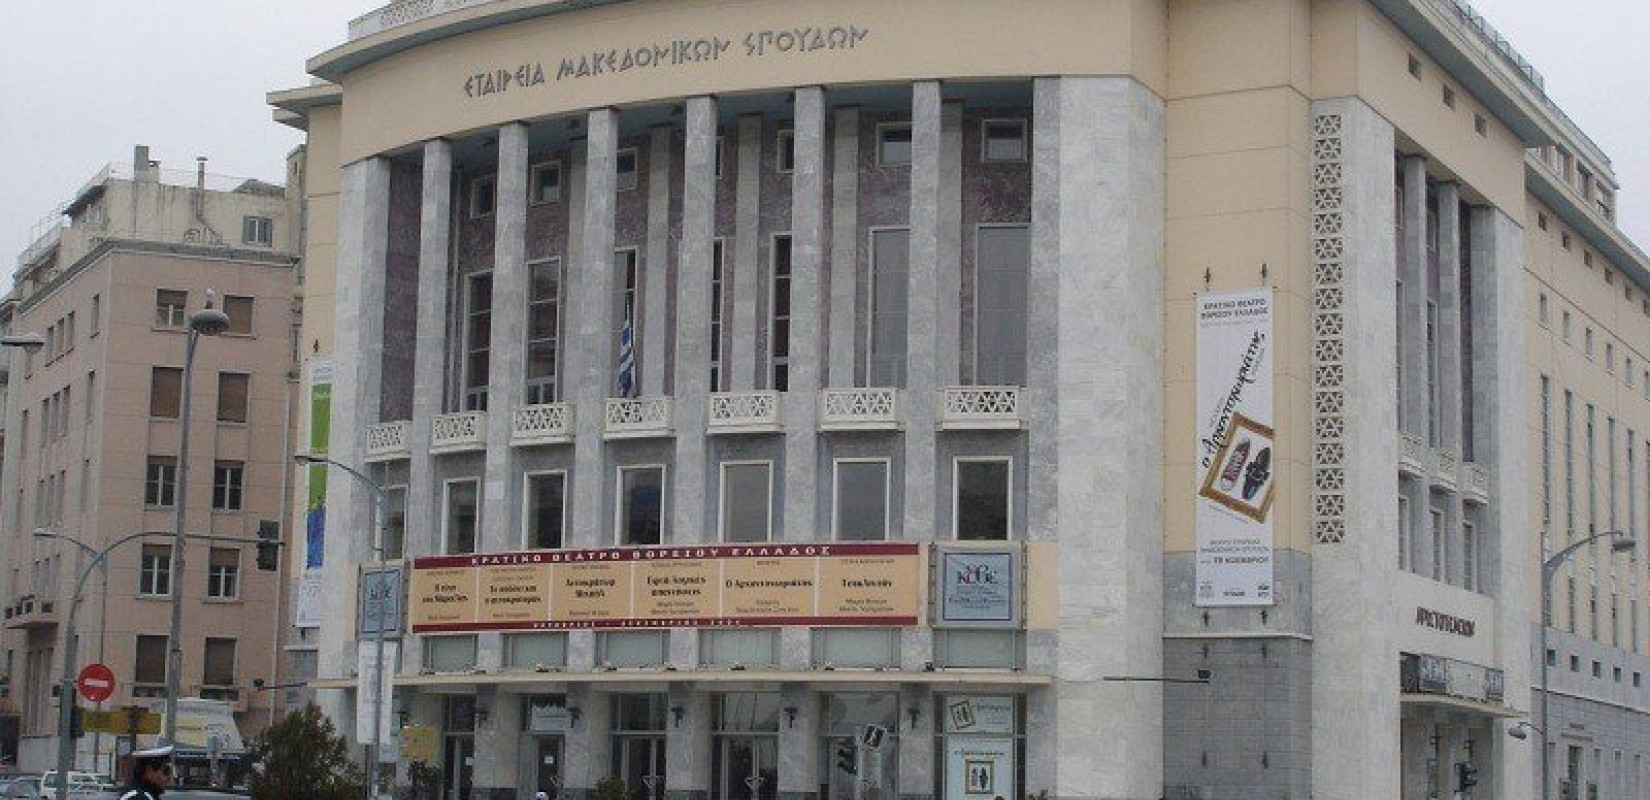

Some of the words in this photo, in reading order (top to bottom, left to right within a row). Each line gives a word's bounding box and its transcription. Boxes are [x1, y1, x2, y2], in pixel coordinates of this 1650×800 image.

[464, 63, 546, 98] ΕΤΑΙΡΕΙΑ
[556, 36, 731, 81] ΜΑΚΕΔΟΝΙΚΩΝ
[471, 556, 542, 565] ΚΡΑΤΙΚΟ
[552, 552, 620, 561] ΘΕΑΤΡΟ
[632, 549, 719, 559] ΒΟΡΕΙΟΥ
[731, 546, 830, 556] ΕΛΛΑΔΟΣ
